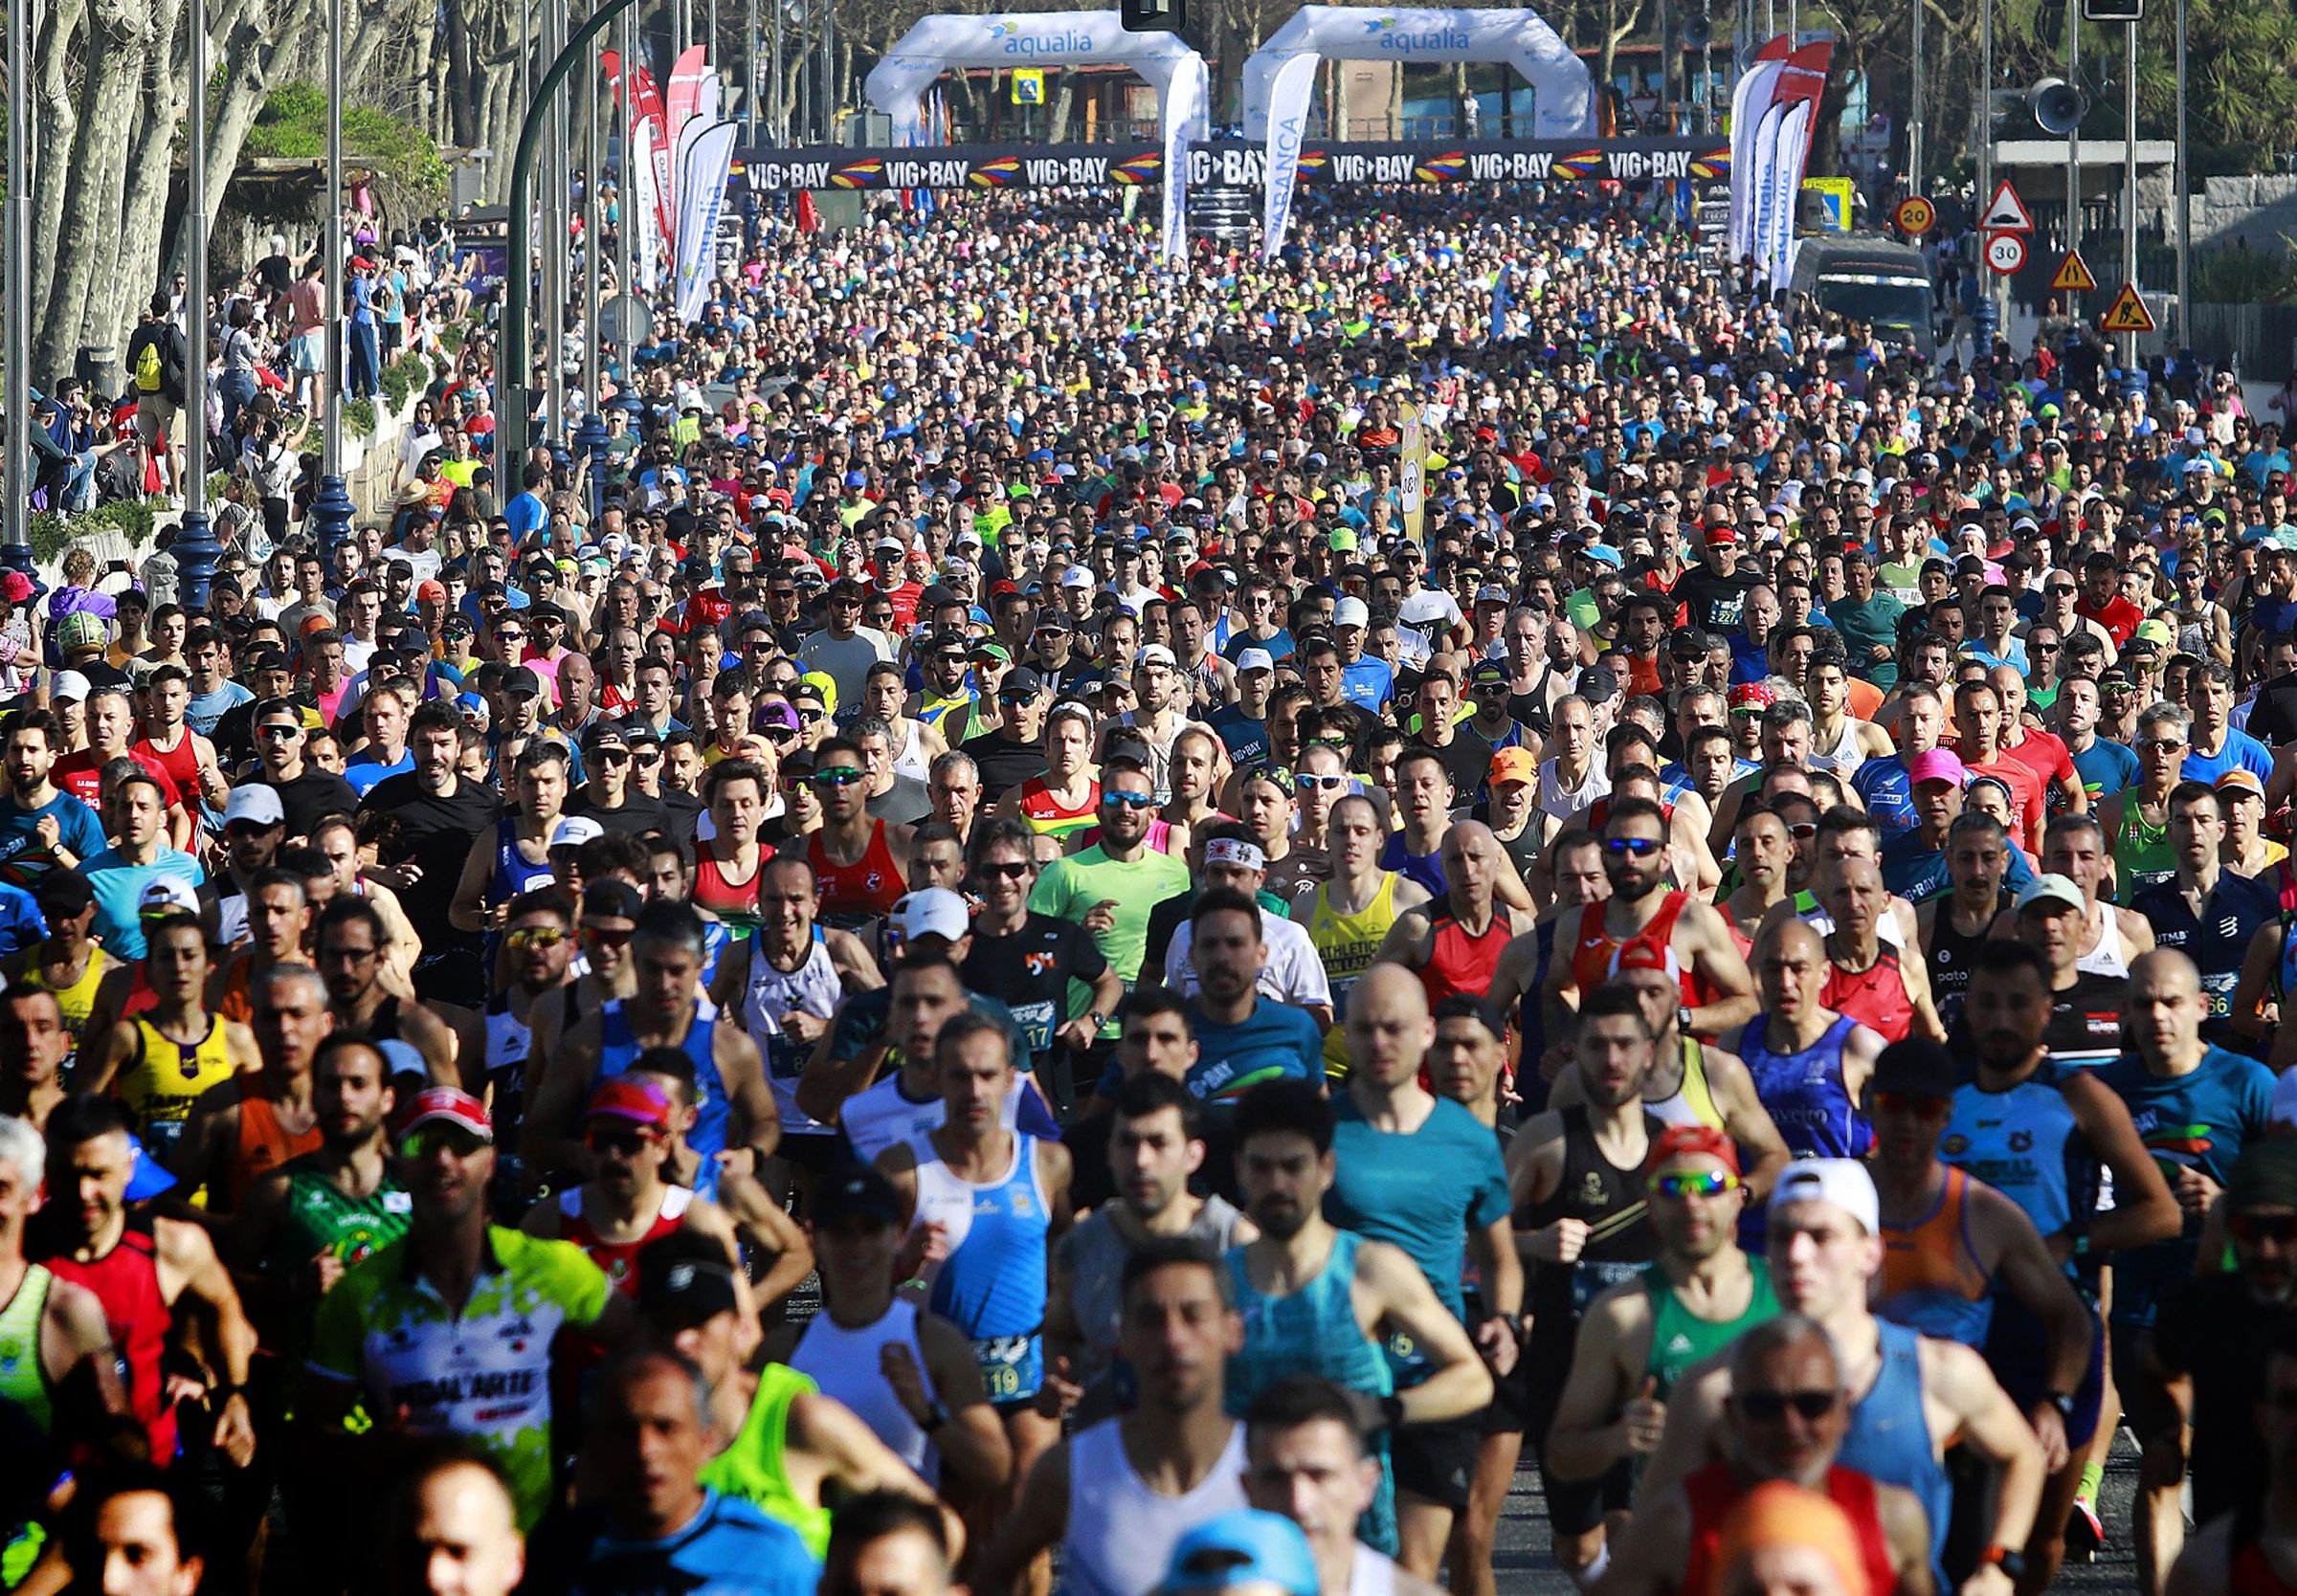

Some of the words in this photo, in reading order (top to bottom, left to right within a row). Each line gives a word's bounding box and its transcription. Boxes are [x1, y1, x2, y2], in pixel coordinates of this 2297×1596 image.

[1005, 30, 1093, 57] aqualia
[1380, 28, 1470, 54] aqualia
[1904, 209, 1926, 223] 20
[1995, 246, 2018, 260] 30
[1718, 613, 1736, 624] 227
